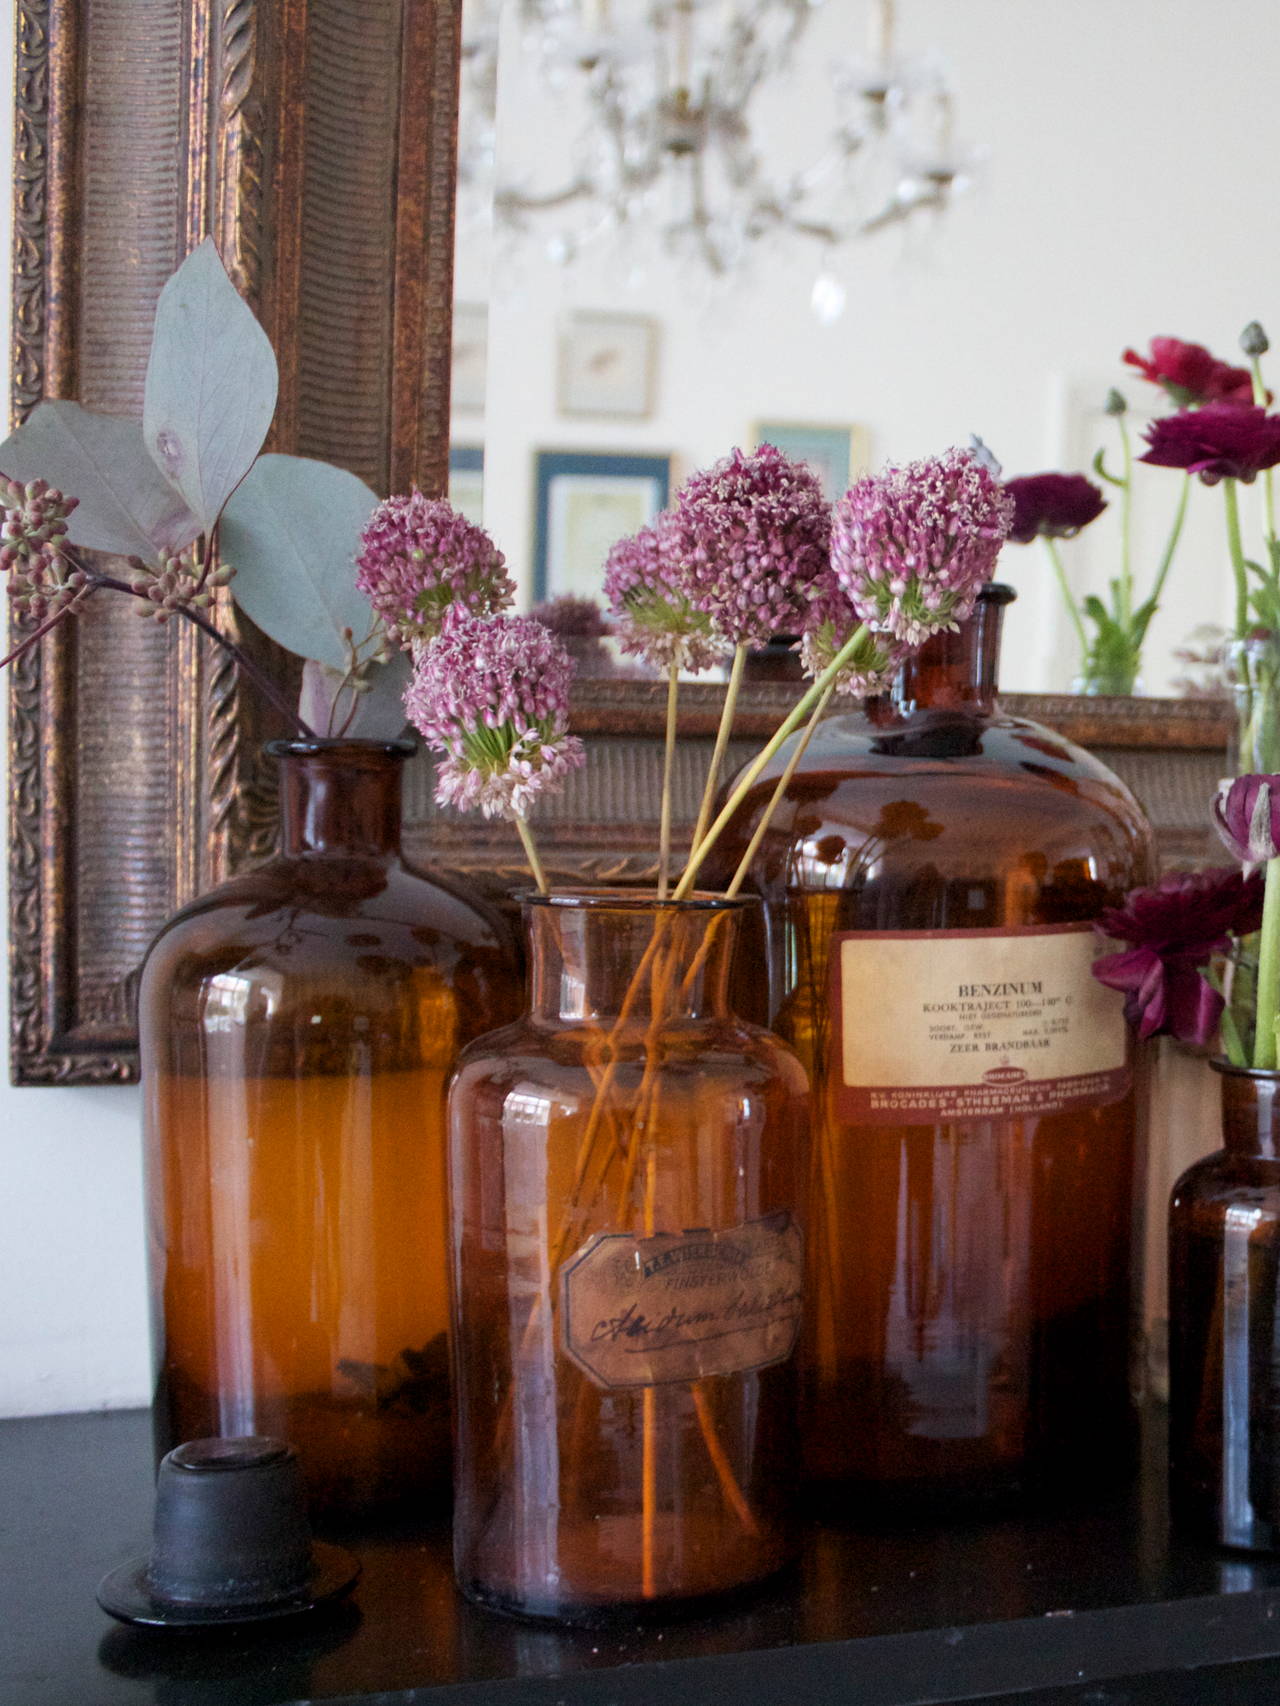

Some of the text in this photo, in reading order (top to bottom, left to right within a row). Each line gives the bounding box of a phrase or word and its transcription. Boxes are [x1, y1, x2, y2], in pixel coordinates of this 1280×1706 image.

[959, 981, 1043, 997] BENZINUM
[923, 1000, 1011, 1013] KOOKTRAJECT
[950, 1037, 1051, 1054] ZEER BRANDBAAR
[940, 1106, 1003, 1116] AMSTERDAM
